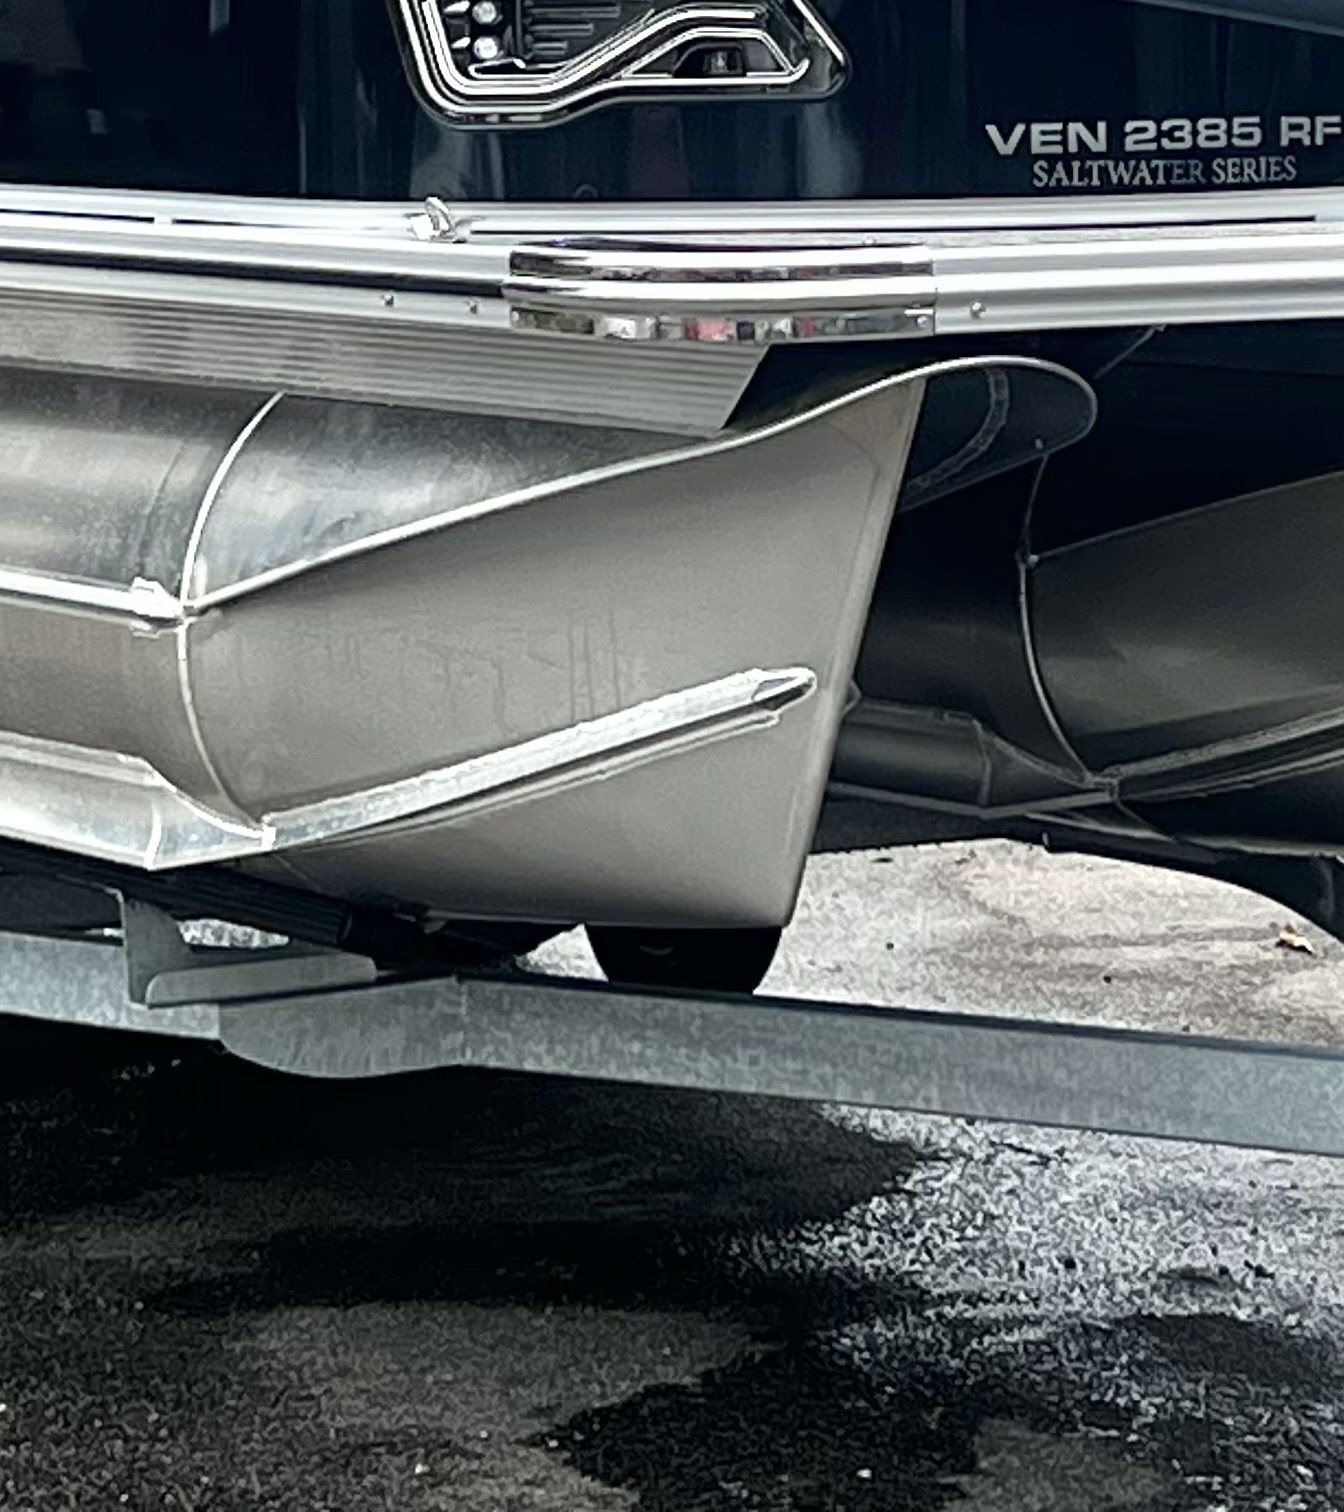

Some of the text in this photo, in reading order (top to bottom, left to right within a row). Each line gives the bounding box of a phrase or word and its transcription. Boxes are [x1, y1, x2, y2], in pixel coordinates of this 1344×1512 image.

[985, 114, 1342, 156] VEN 2385 RF
[1032, 155, 1298, 188] SALTWATER SERIES
